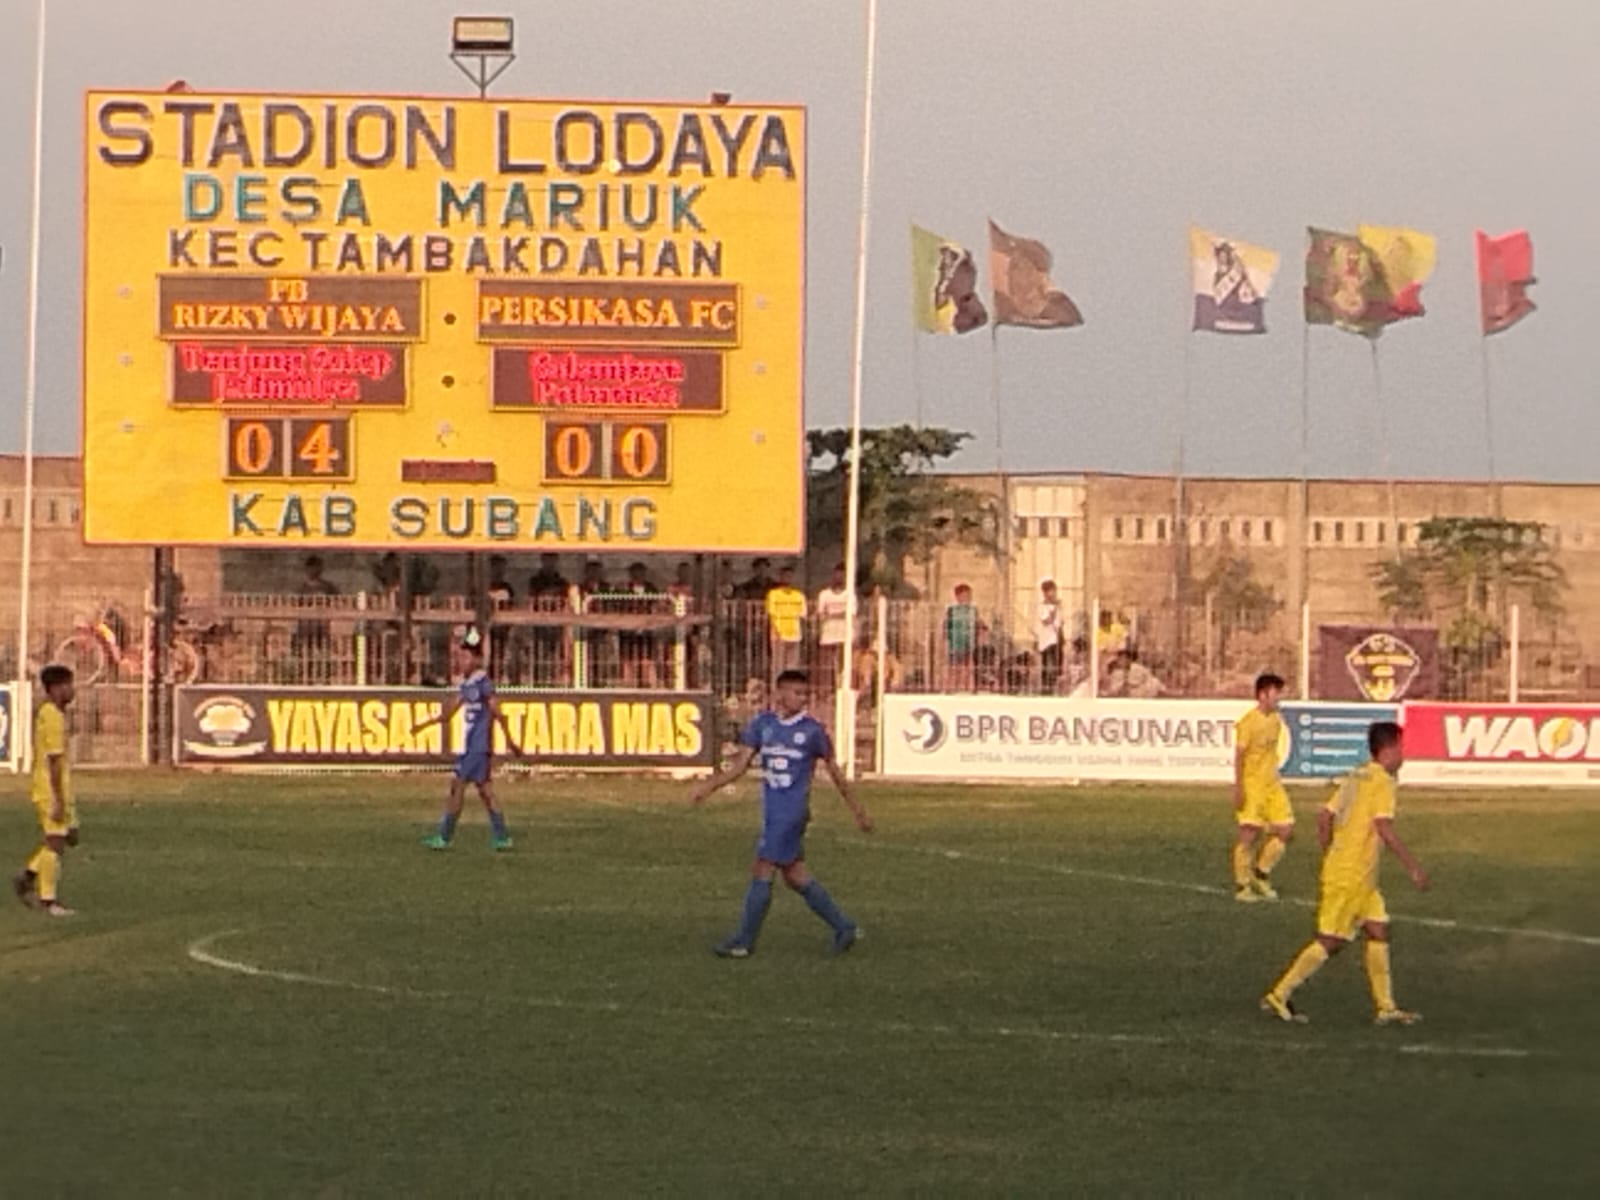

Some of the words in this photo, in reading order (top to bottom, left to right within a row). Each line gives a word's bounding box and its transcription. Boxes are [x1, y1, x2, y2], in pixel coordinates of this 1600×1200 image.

[98, 99, 456, 170] STADION
[498, 109, 796, 180] LODAYA
[184, 174, 371, 226] DESA
[438, 181, 707, 233] MARIUK
[169, 229, 284, 268] KEC
[302, 232, 723, 277] TAMBAKDAHAN
[173, 303, 272, 330] RIZKY
[277, 304, 406, 337] WIJAYA
[479, 297, 682, 328] PERSIKASA
[689, 300, 738, 331] FC
[231, 494, 357, 537] KAB
[391, 496, 657, 540] SUBANG
[611, 703, 702, 756] MAS
[955, 714, 1016, 744] BPR
